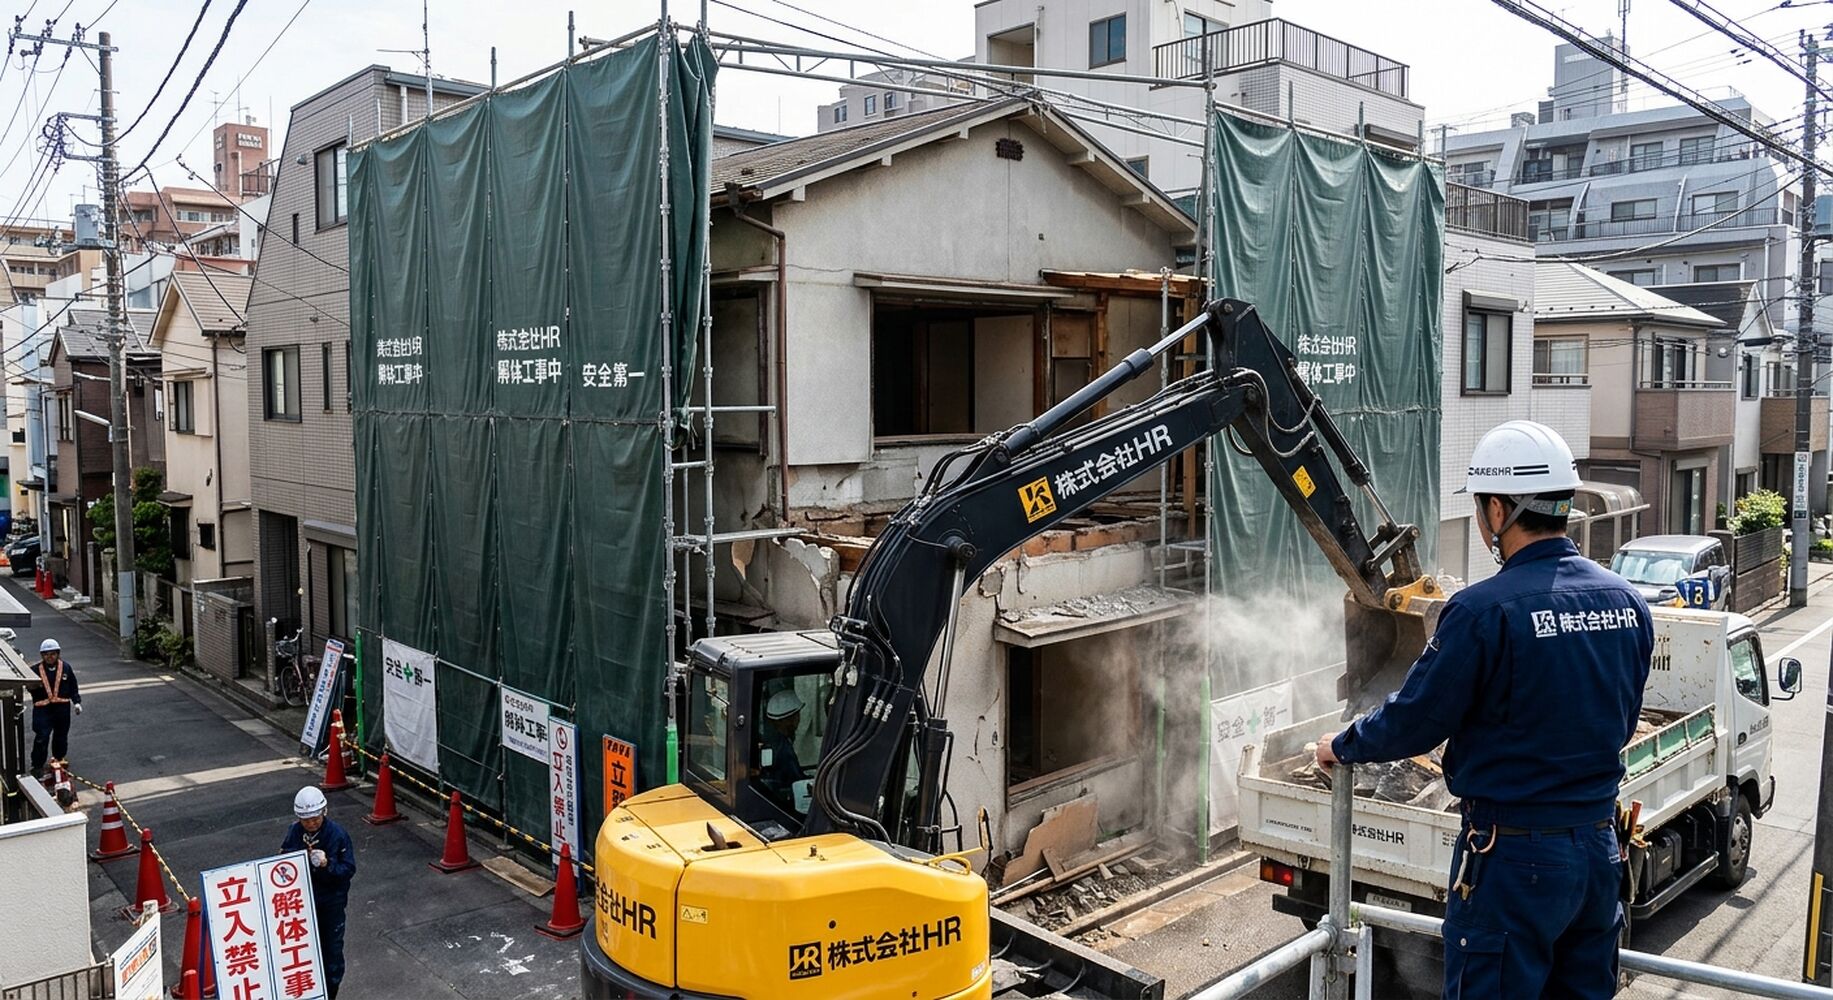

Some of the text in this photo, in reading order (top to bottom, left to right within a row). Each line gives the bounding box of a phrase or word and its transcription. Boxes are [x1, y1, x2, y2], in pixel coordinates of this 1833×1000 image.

[582, 362, 645, 387] 安全第一
[1054, 424, 1173, 500] 株式会社HR
[1559, 608, 1639, 633] 株式会社HR
[217, 877, 261, 1000] 立入禁止
[272, 888, 316, 999] 解体工事
[828, 916, 962, 970] 株式会社HR
